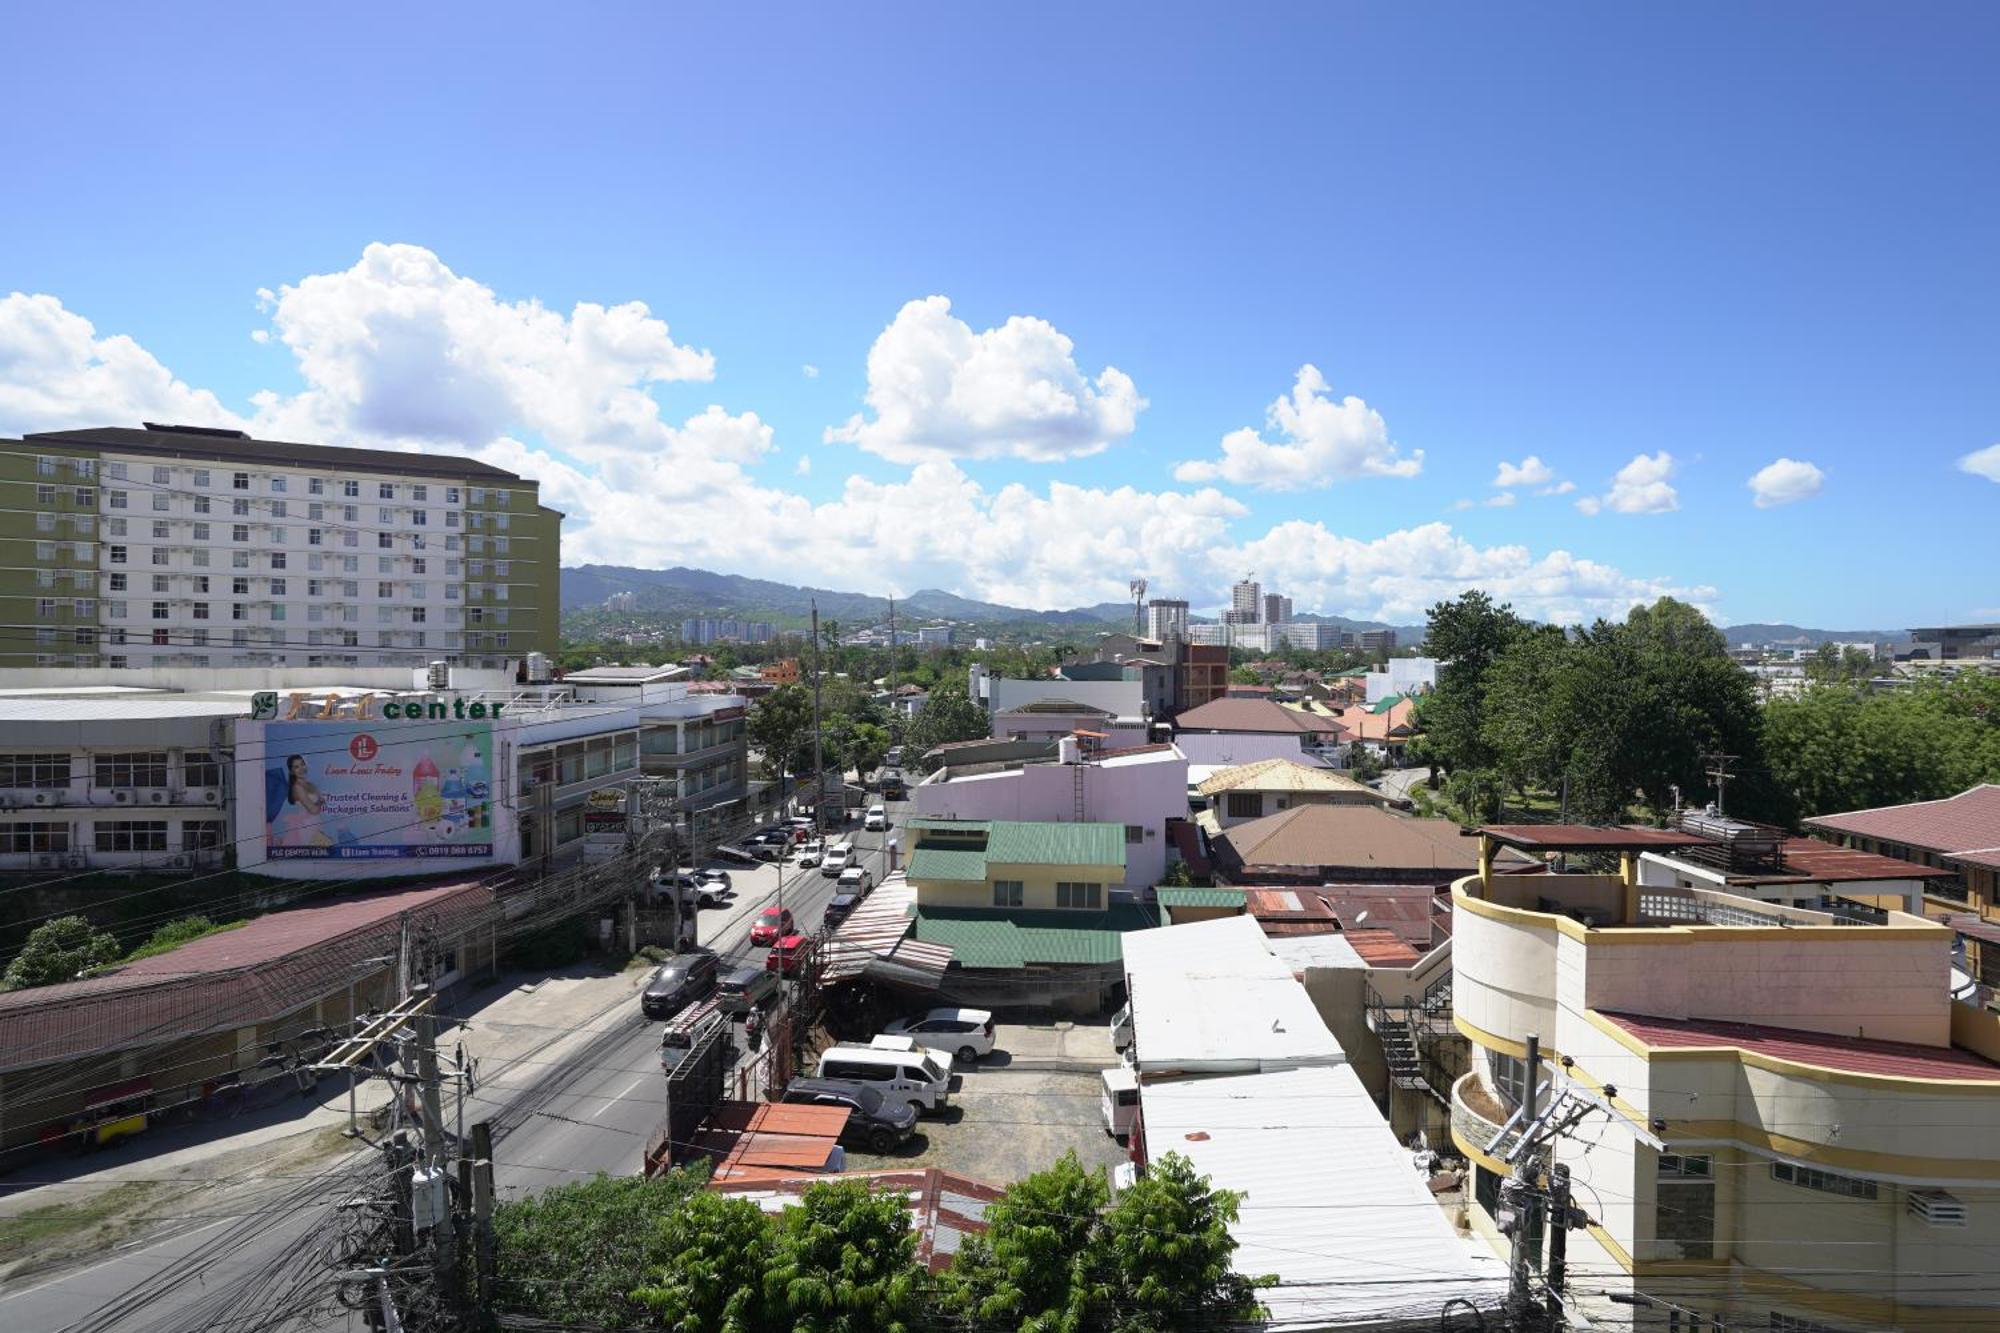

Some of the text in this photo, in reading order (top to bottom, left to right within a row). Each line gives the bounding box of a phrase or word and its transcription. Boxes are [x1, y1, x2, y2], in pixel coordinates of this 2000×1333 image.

[383, 697, 505, 719] center
[361, 792, 400, 803] Cleaning
[322, 804, 369, 815] Packaging
